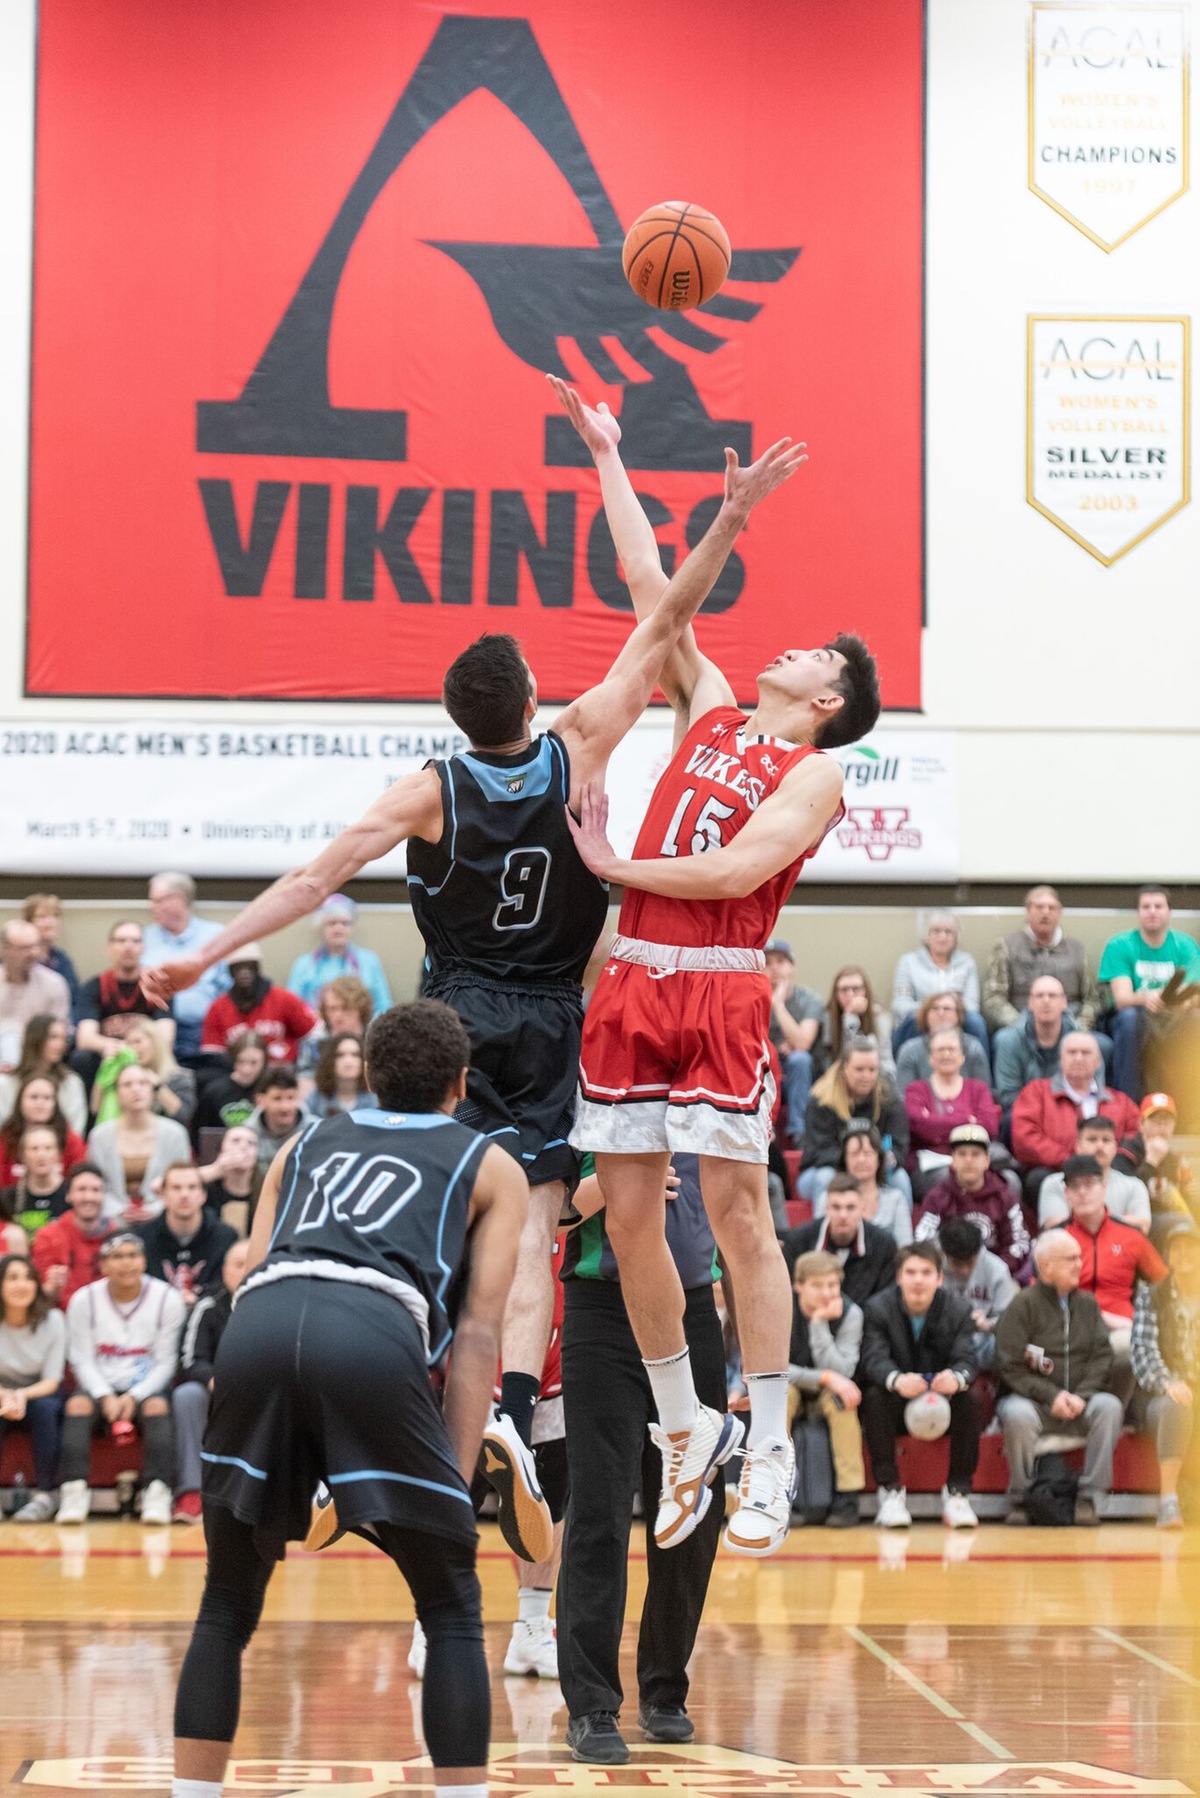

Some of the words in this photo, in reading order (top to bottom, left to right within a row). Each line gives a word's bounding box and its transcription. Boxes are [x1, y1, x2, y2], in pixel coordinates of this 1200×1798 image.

[1040, 145, 1178, 164] CHAMPIONS
[1059, 395, 1158, 411] WOMEN'S
[1049, 419, 1170, 434] VOLLEYBALL
[1046, 447, 1168, 465] SILVER
[1048, 469, 1166, 481] MEDALIST
[1078, 494, 1139, 512] 2003
[196, 477, 747, 614] VIKINGS
[2, 730, 58, 755] 2020
[64, 731, 128, 756] ACAC
[136, 732, 210, 757] MEN'S
[217, 733, 371, 758] BASKETBALL
[379, 735, 467, 758] CHAMP
[684, 744, 767, 811] VIKES
[839, 755, 900, 788] rgill
[26, 818, 81, 838] March
[128, 819, 169, 839] 2020
[201, 819, 292, 843] University
[299, 820, 317, 839] of
[660, 787, 738, 858] 15
[837, 828, 922, 849] VIKINGS
[492, 846, 552, 932] 9
[294, 1152, 423, 1235] 10
